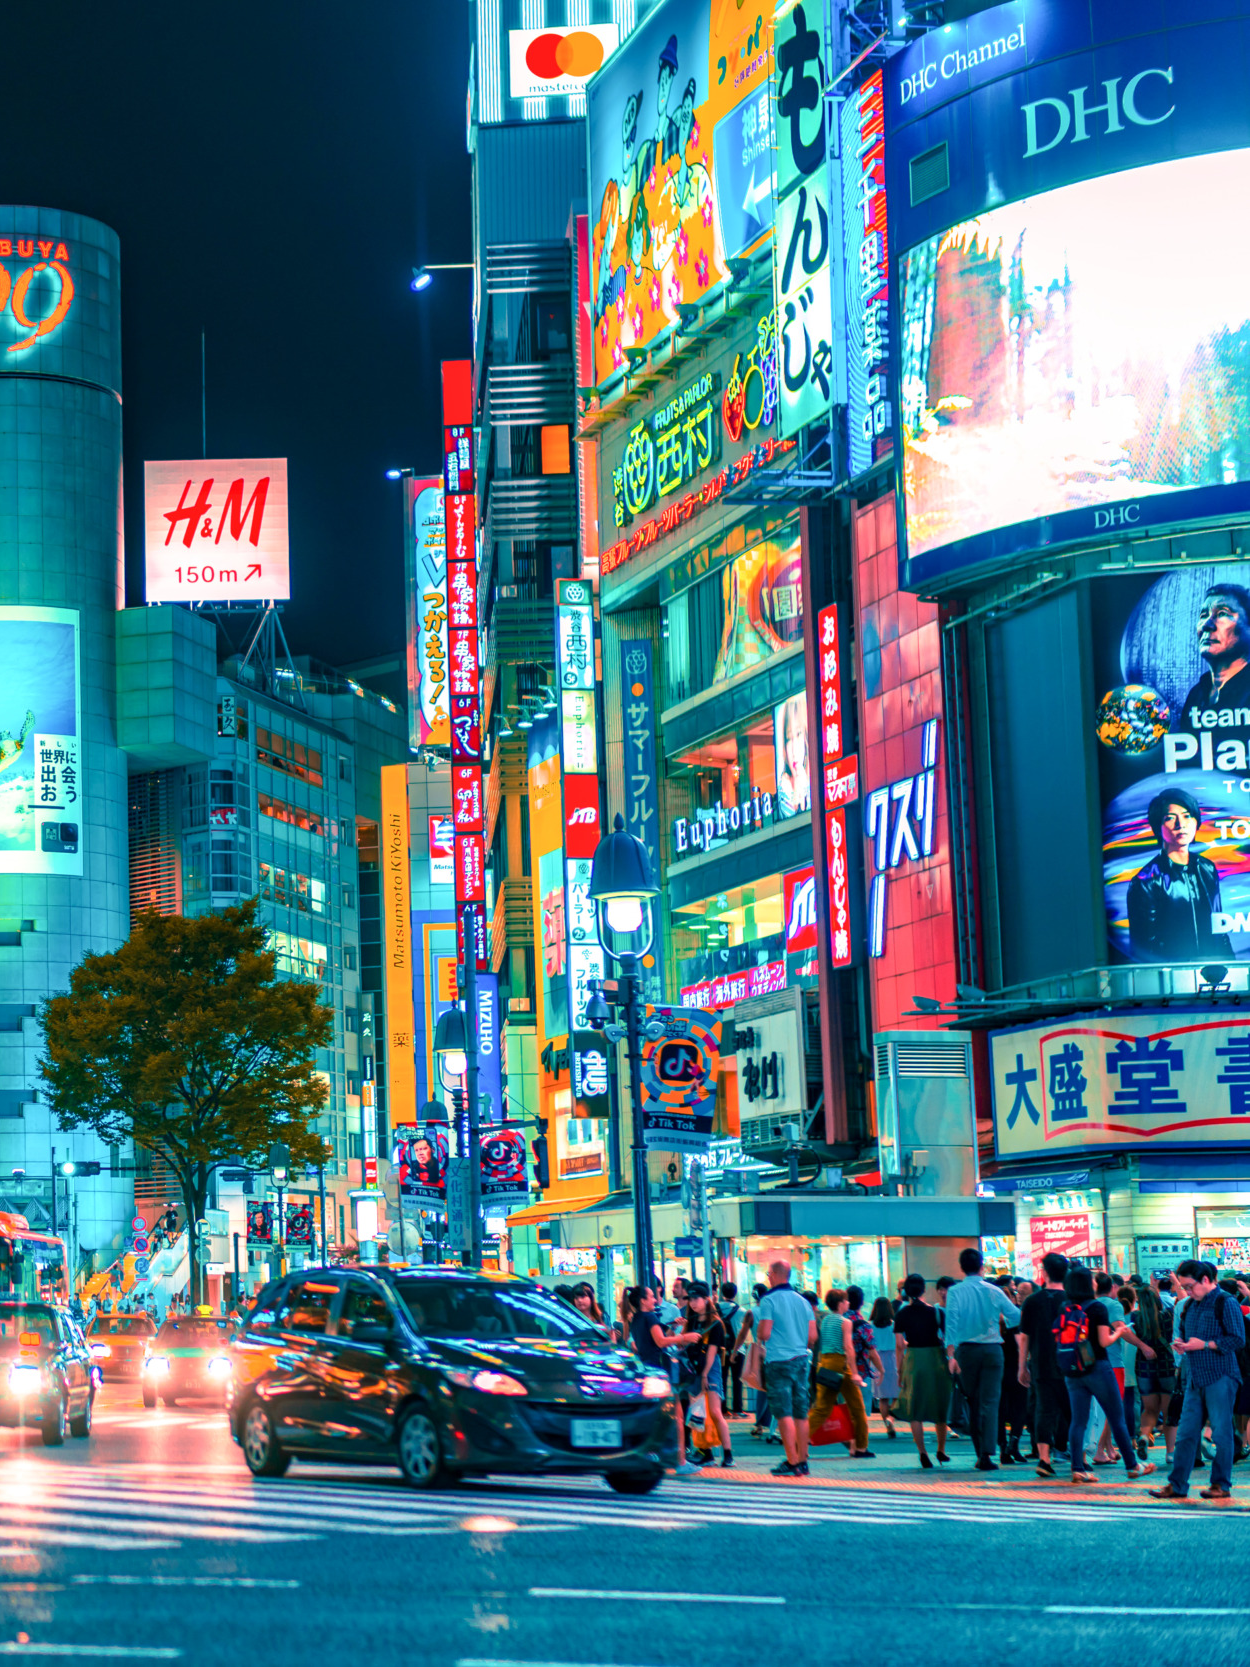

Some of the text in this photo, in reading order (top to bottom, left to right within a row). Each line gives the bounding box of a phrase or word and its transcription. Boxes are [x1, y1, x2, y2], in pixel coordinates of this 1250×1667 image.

[900, 23, 1026, 106] DHC Channel
[1020, 66, 1176, 159] DHC
[776, 3, 832, 401] もんじゃ
[656, 400, 713, 497] 西村
[162, 475, 271, 549] H&M
[1094, 504, 1141, 529] DHC
[173, 564, 239, 585] 150m
[566, 609, 588, 670] 渋谷西村
[566, 674, 577, 684] 5F
[458, 698, 471, 707] 6F
[40, 748, 78, 765] 世界に
[461, 769, 472, 778] 6F
[568, 807, 597, 825] JTB
[674, 785, 774, 856] Euphoria
[462, 837, 475, 847] 6F
[389, 813, 406, 969] KiYoshi Matsumoto
[573, 882, 585, 925] パーラー
[575, 968, 588, 1012] フルーツ
[715, 978, 746, 1004] 海外旅行
[479, 989, 494, 1055] MIZUHO
[582, 1050, 608, 1097] HUB
[658, 1117, 696, 1131] Tik Tok
[449, 1164, 464, 1238] 文化村通り
[1015, 1178, 1054, 1190] TAISEIDO
[1140, 1244, 1190, 1254] 大盛堂書店
